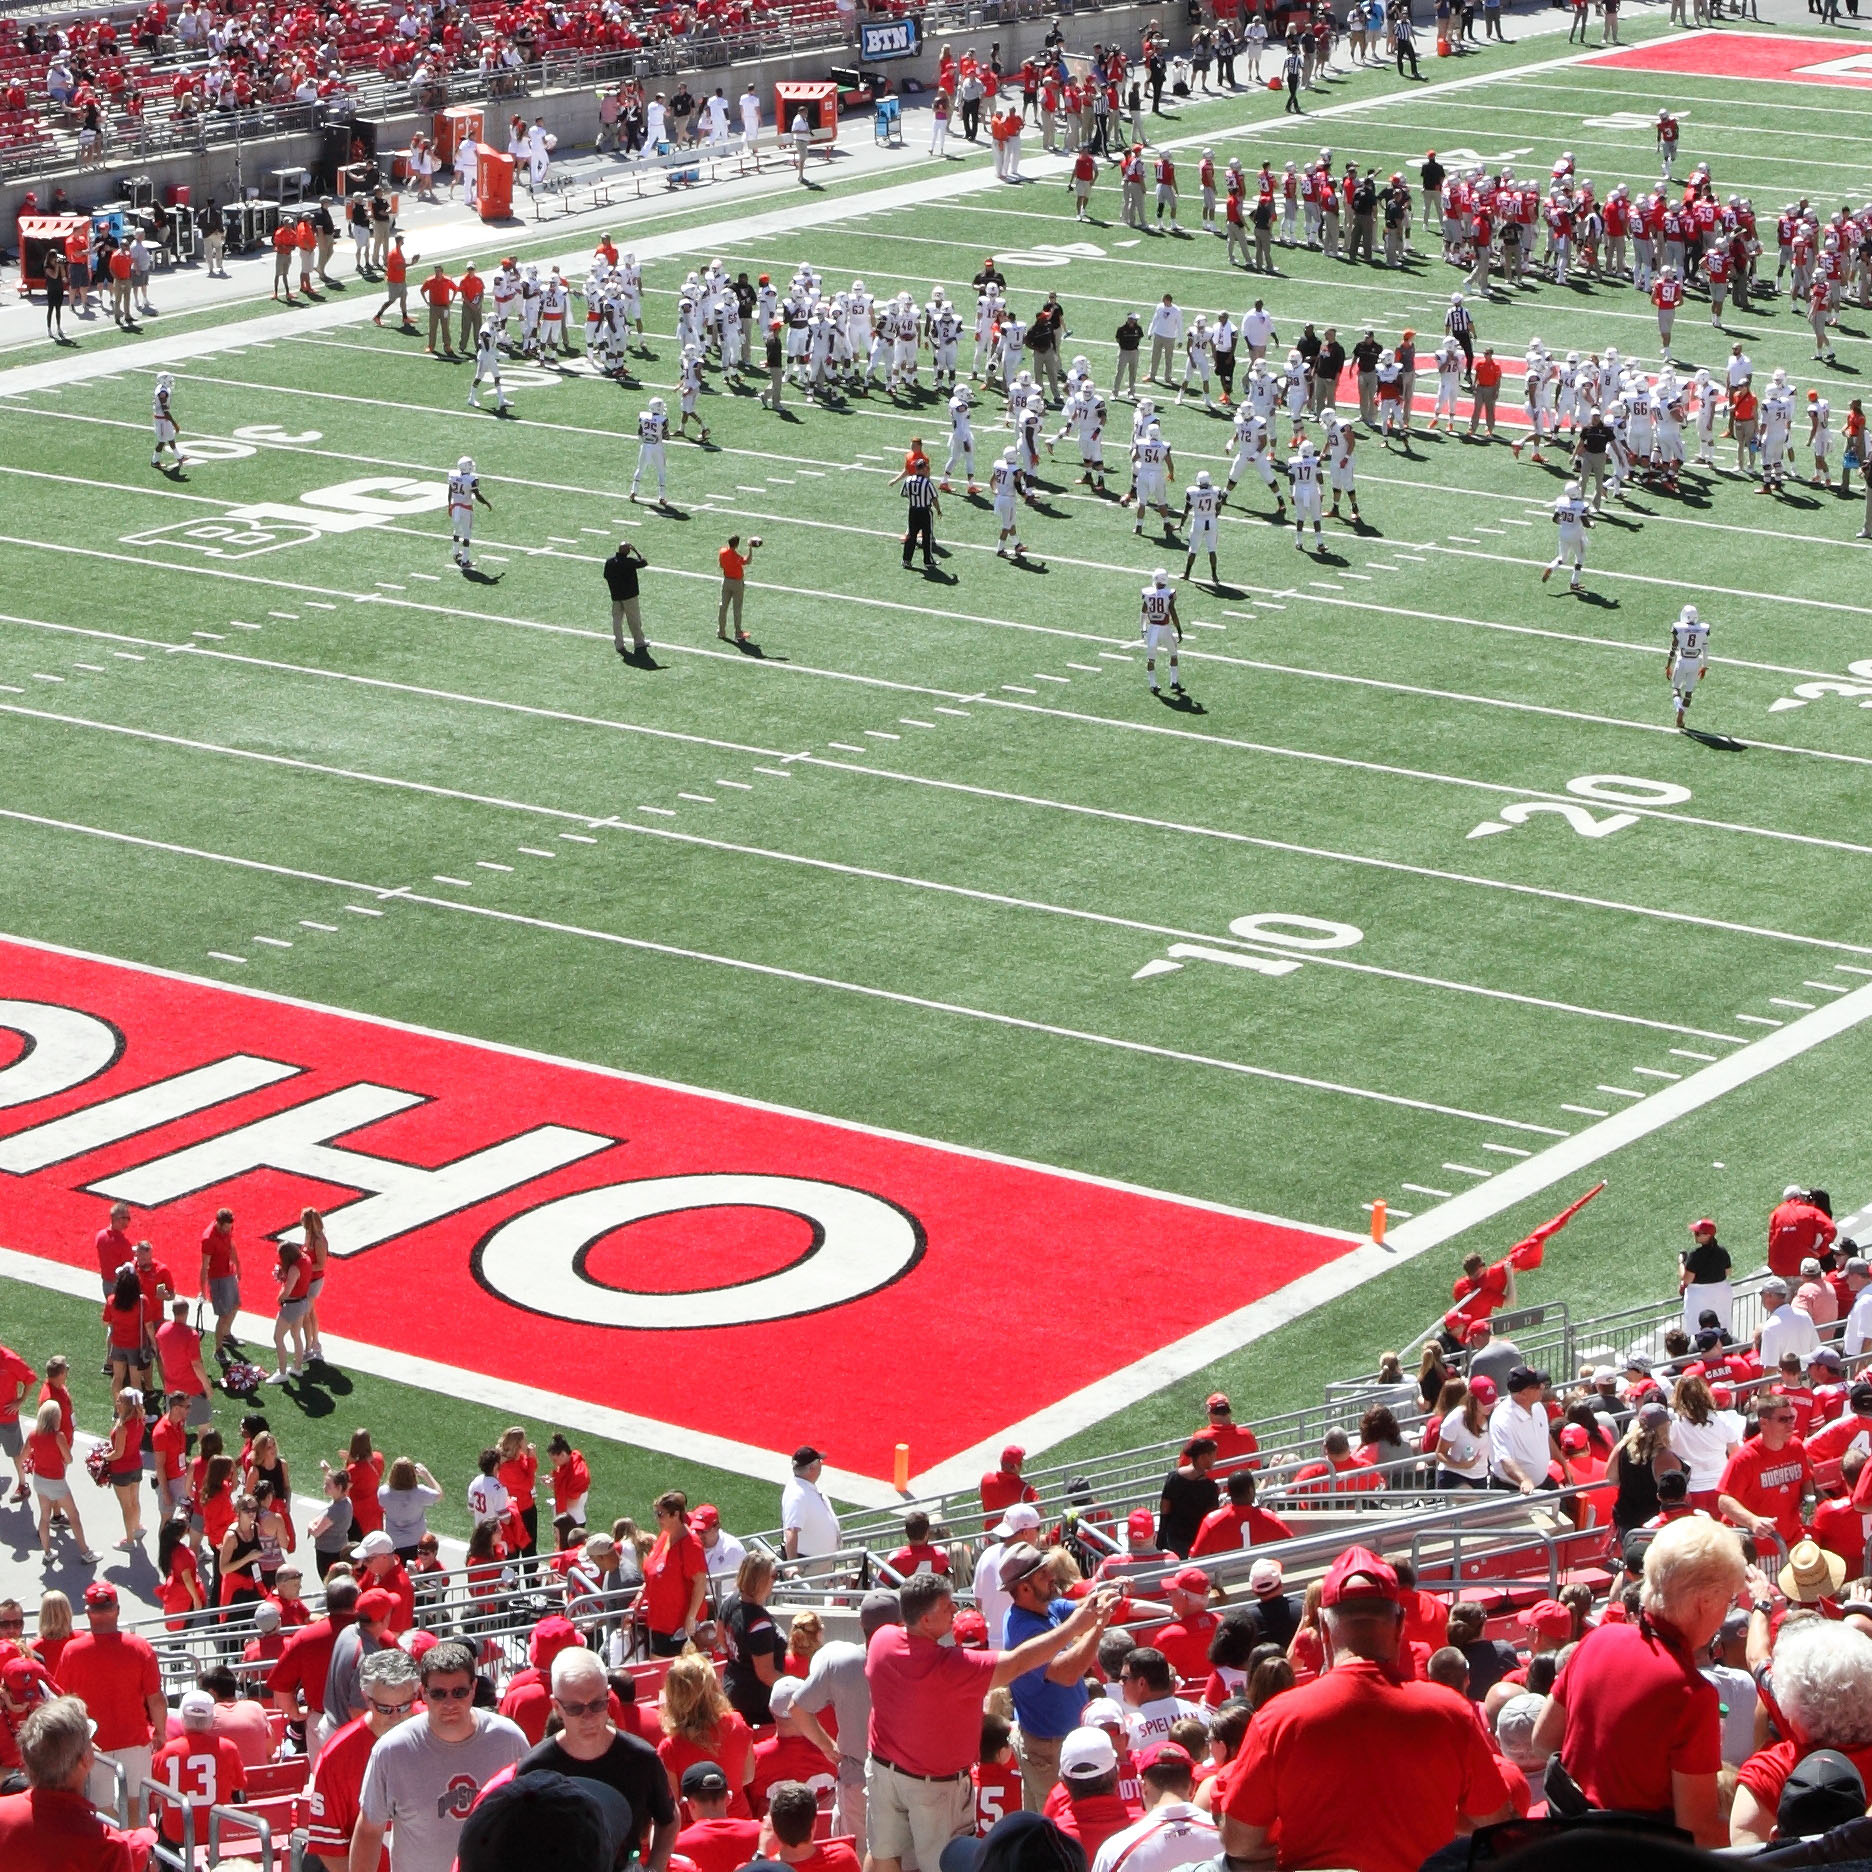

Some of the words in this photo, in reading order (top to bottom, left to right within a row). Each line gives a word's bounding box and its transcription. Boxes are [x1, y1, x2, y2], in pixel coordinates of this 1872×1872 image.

[866, 25, 908, 53] BTN
[1661, 286, 1675, 302] 91
[1604, 374, 1611, 386] 8
[1632, 402, 1648, 415] 66
[1144, 448, 1160, 464] 54
[1297, 465, 1312, 480] 17
[1198, 498, 1213, 512] 47
[1148, 596, 1165, 614] 38
[1687, 633, 1697, 648] 8
[1500, 774, 1692, 839] 20
[1167, 912, 1365, 977] 10
[1238, 1520, 1251, 1548] 1
[165, 1753, 219, 1808] 13
